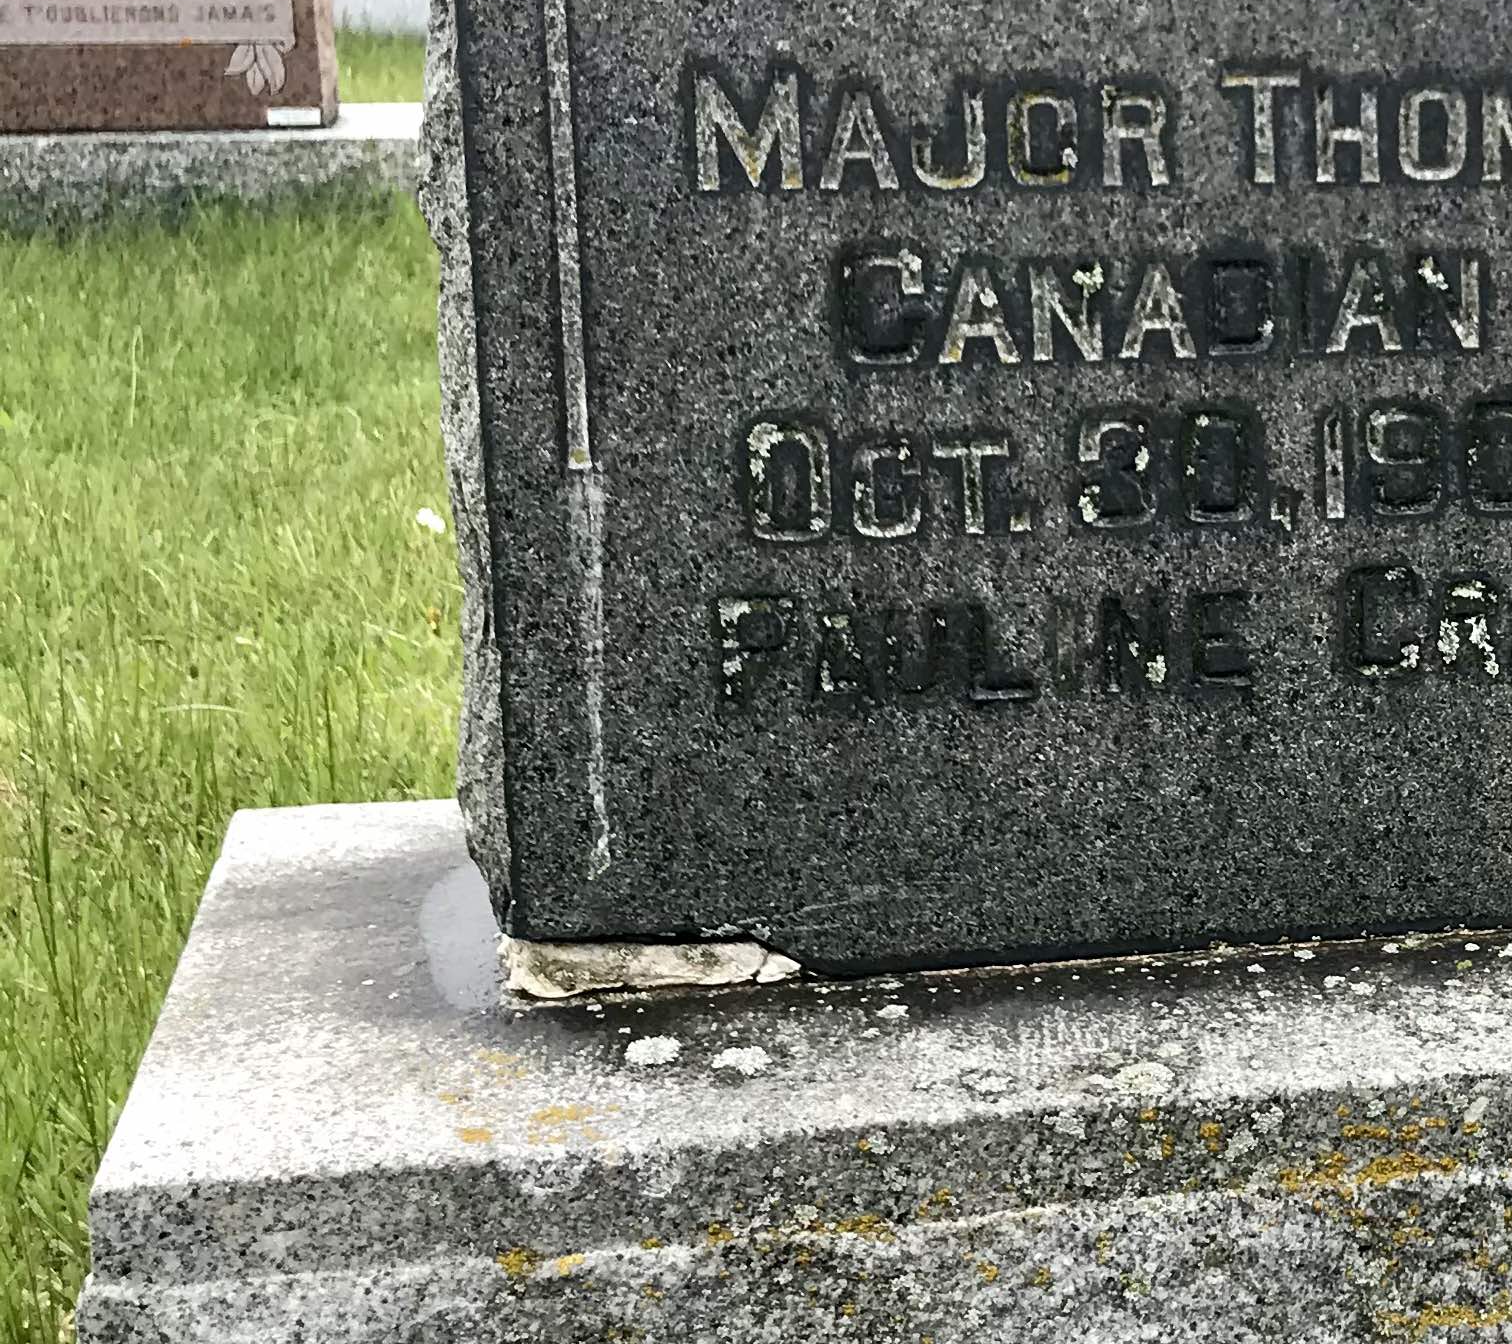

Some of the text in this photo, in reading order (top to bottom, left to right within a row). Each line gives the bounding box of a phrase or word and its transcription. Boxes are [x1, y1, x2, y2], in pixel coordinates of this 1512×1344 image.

[690, 70, 1172, 193] MAJOR
[842, 251, 1480, 365] CANADIAN
[743, 416, 1032, 542] OCT.
[712, 592, 1254, 702] PAULINE
